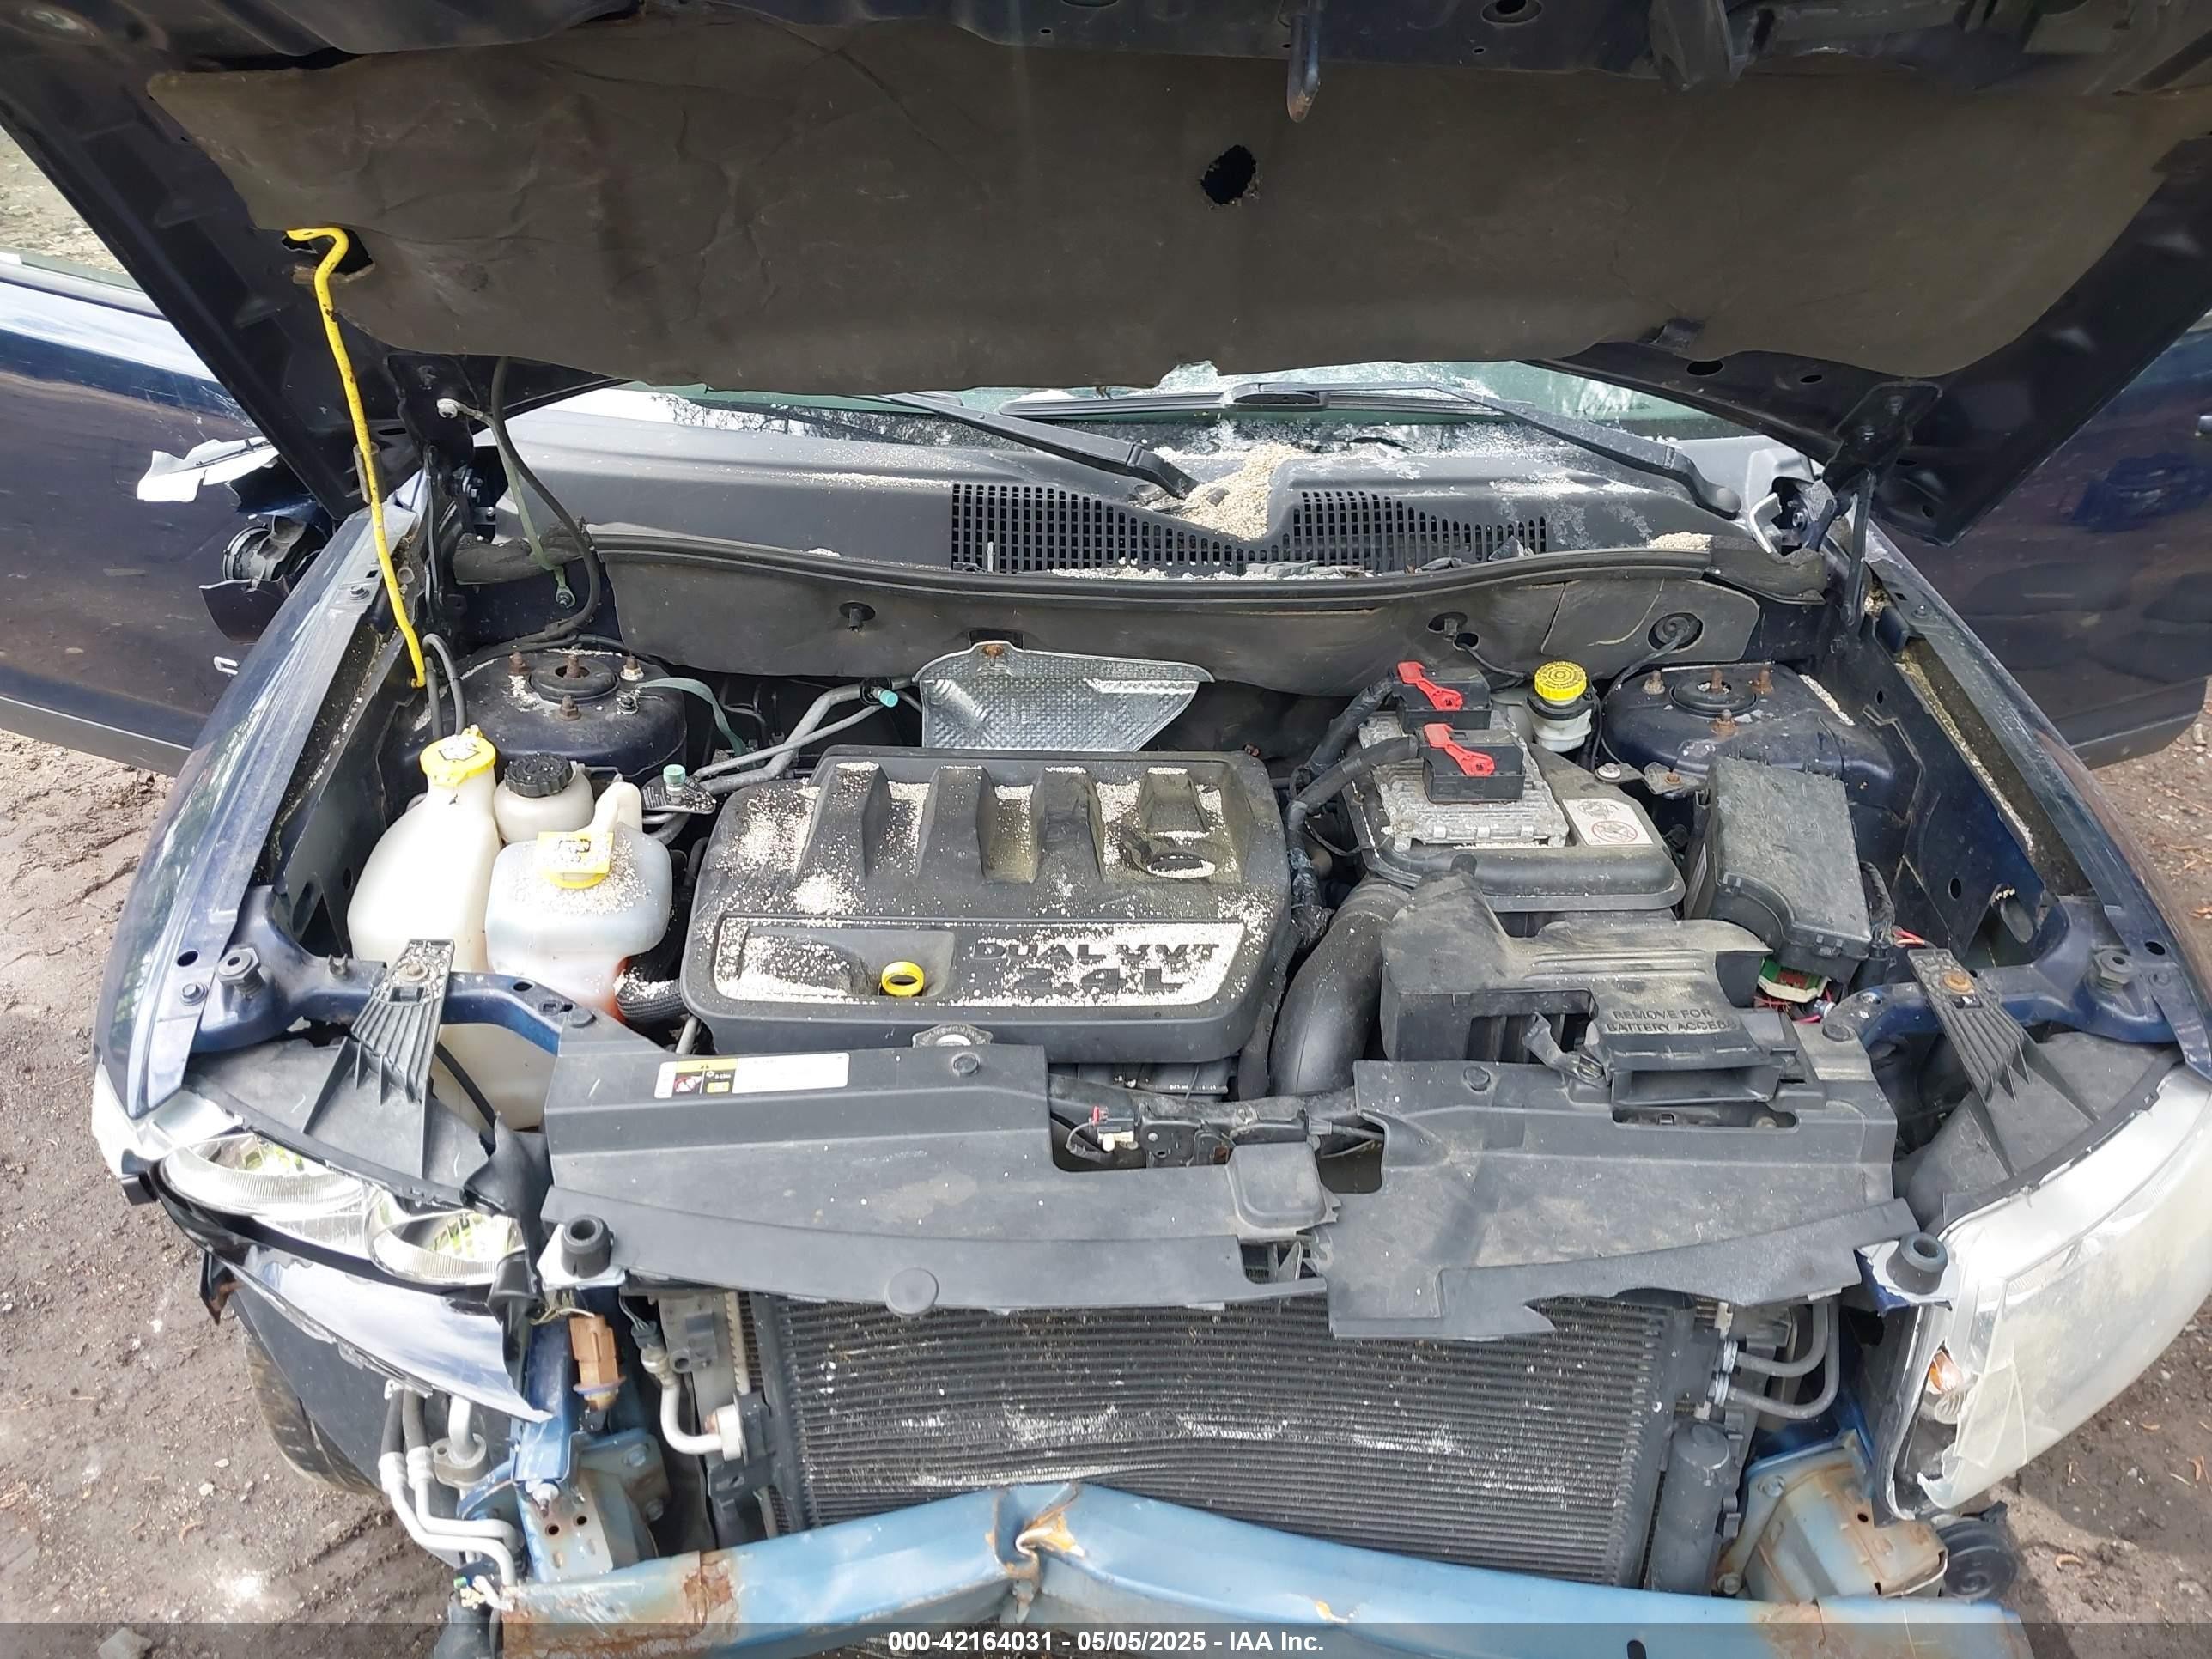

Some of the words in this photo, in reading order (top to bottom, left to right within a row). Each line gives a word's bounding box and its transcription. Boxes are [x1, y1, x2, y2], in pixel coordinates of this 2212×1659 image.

[971, 943, 1107, 963] DUAL
[1116, 943, 1220, 963] VVT
[1013, 967, 1184, 992] 2.4L
[1613, 1009, 1678, 1020] REMOVE
[1680, 1007, 1712, 1018] FOR
[1606, 1022, 1670, 1033] BATTERY
